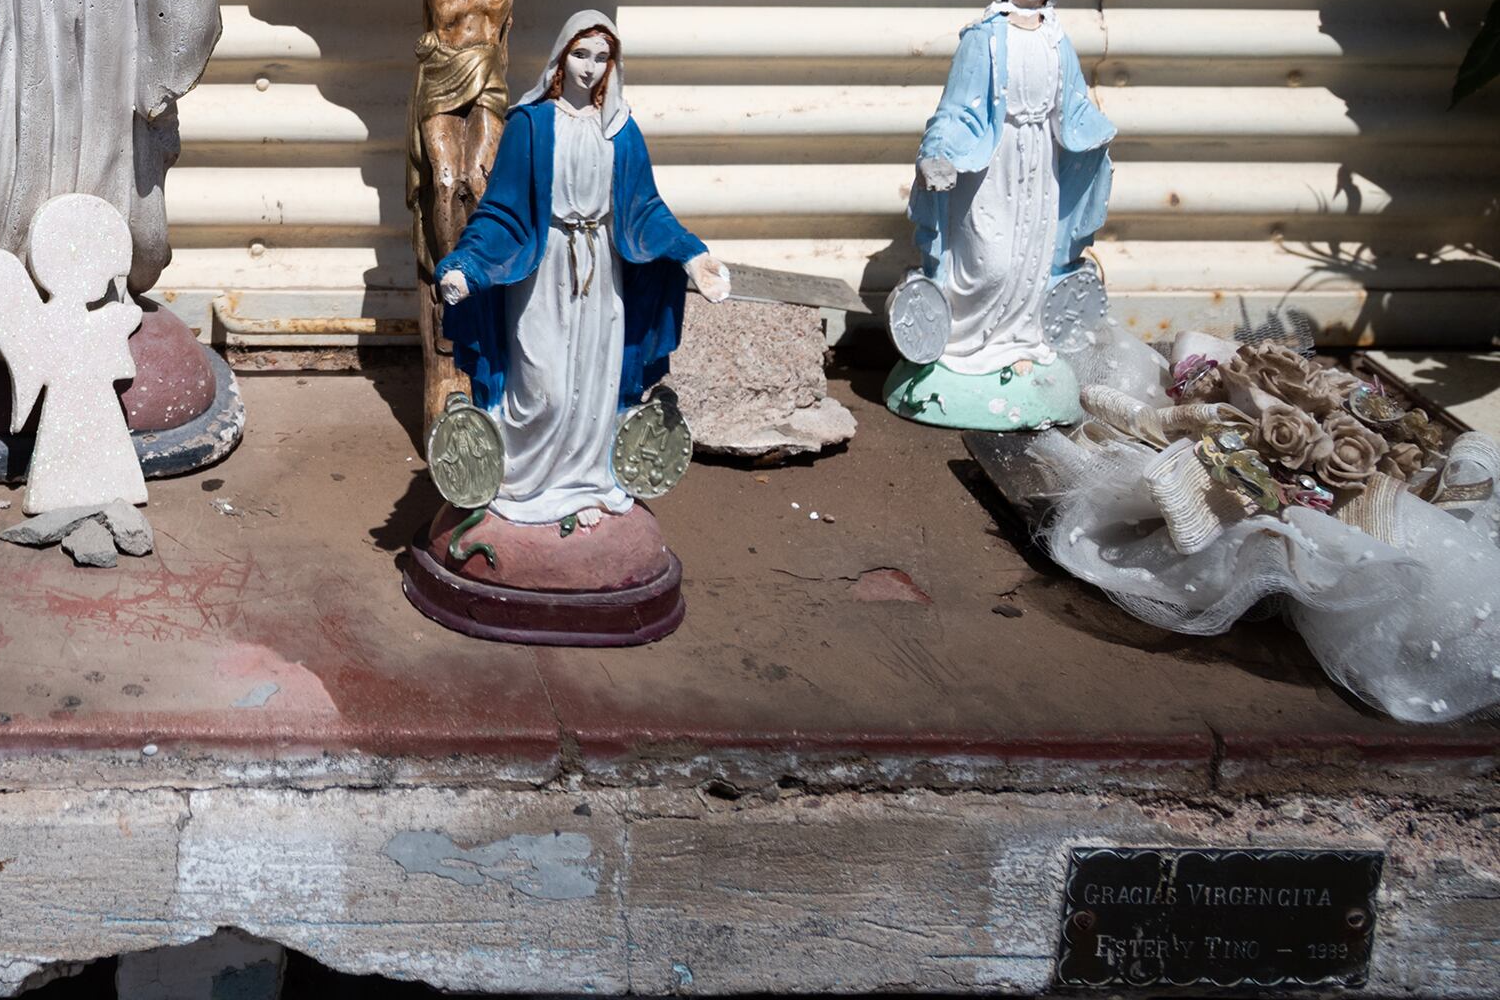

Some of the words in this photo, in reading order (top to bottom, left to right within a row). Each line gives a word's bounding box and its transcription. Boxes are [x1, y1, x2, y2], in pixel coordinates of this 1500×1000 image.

[1084, 883, 1178, 906] GRACIAS
[1186, 883, 1333, 907] VIRGENCITA
[1203, 936, 1260, 959] TINO
